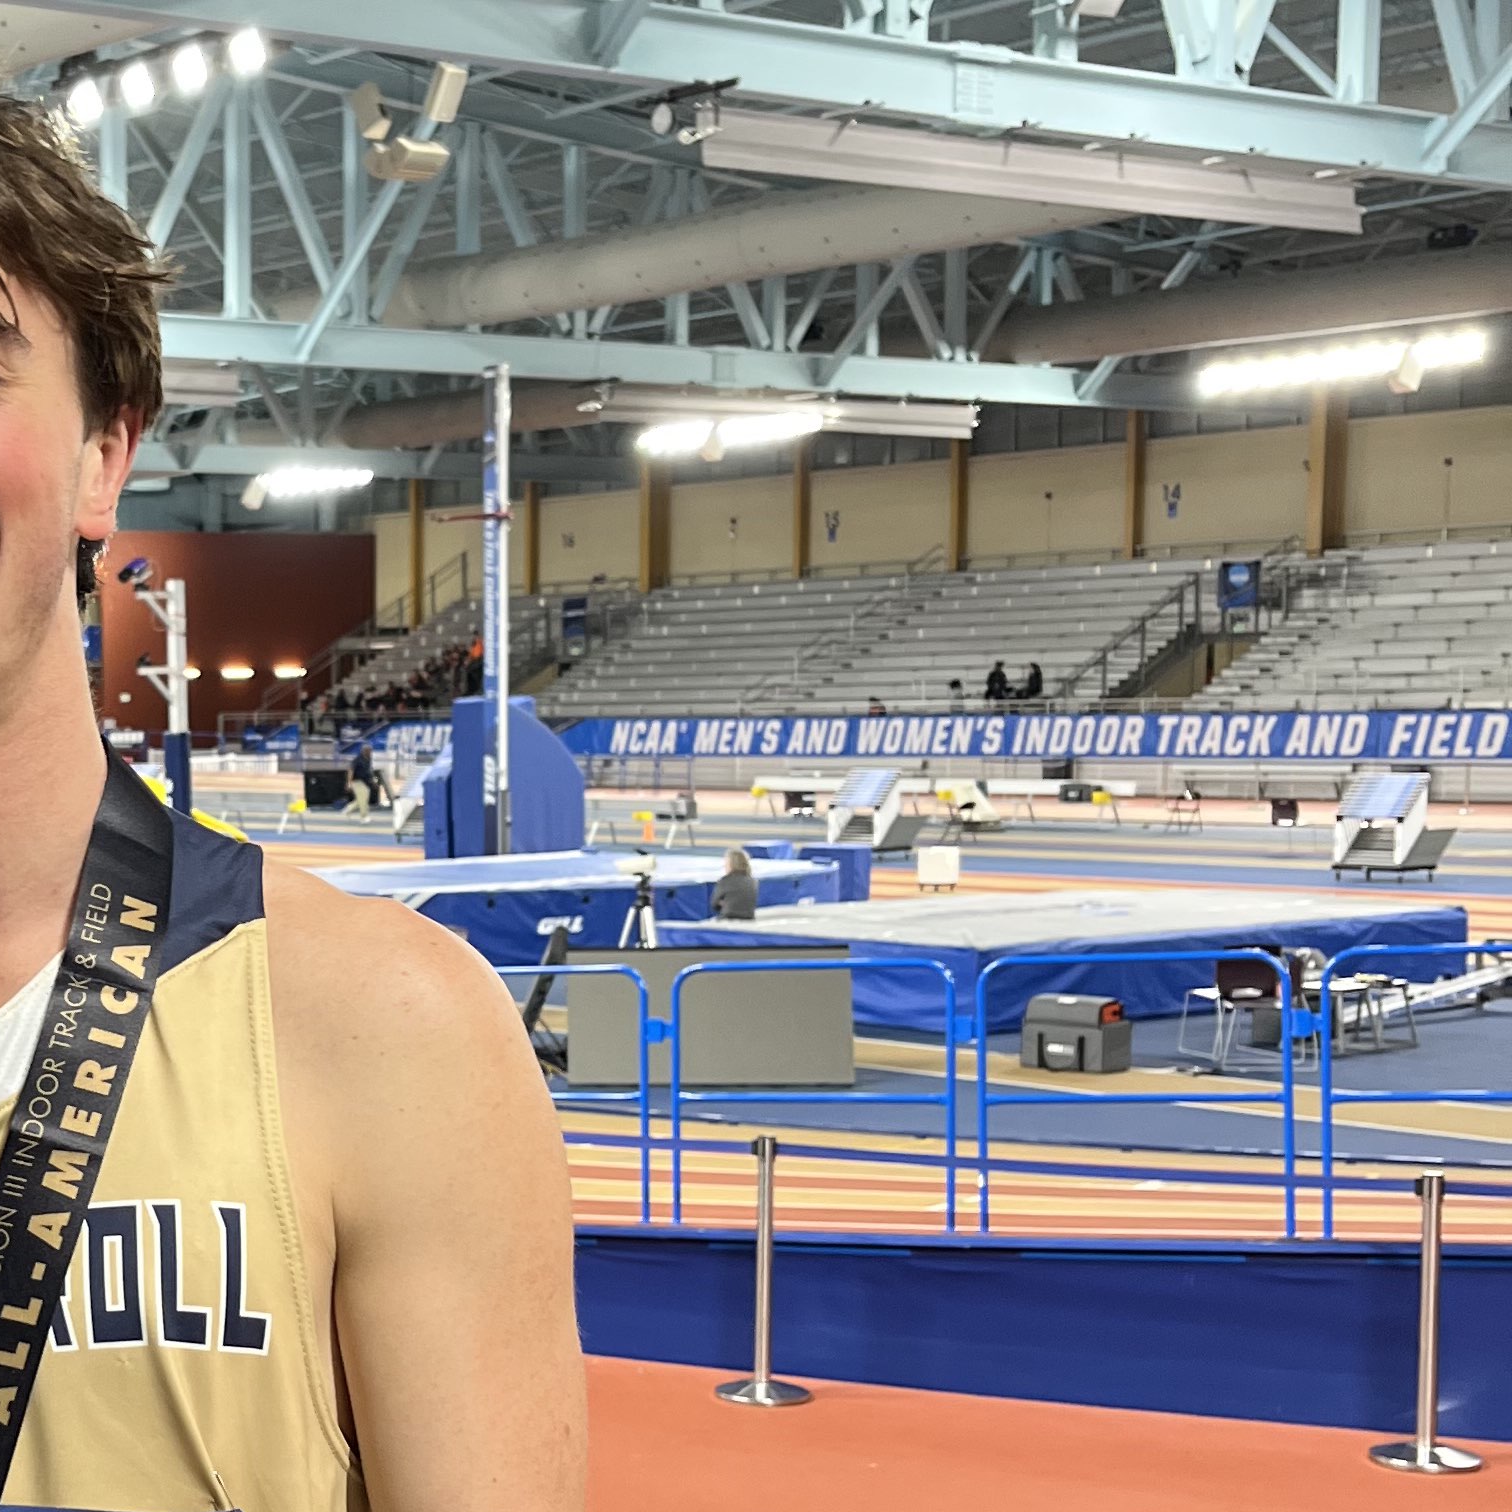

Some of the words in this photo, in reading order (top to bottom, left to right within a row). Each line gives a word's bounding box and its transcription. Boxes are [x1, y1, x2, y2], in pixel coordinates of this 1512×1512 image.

[610, 720, 680, 755] NCAA
[694, 719, 779, 755] MEN'S
[787, 719, 852, 755] AND
[857, 716, 1005, 755] WOMEN'S
[1012, 715, 1145, 756] INDOOR
[1156, 714, 1275, 756] TRACK
[1285, 713, 1370, 757] AND
[1389, 713, 1511, 758] FIELD
[80, 882, 112, 944] FIELD
[75, 953, 97, 969] &
[48, 973, 92, 1049] TRACK
[12, 1057, 66, 1169] INDOOR
[2, 1174, 27, 1198] III
